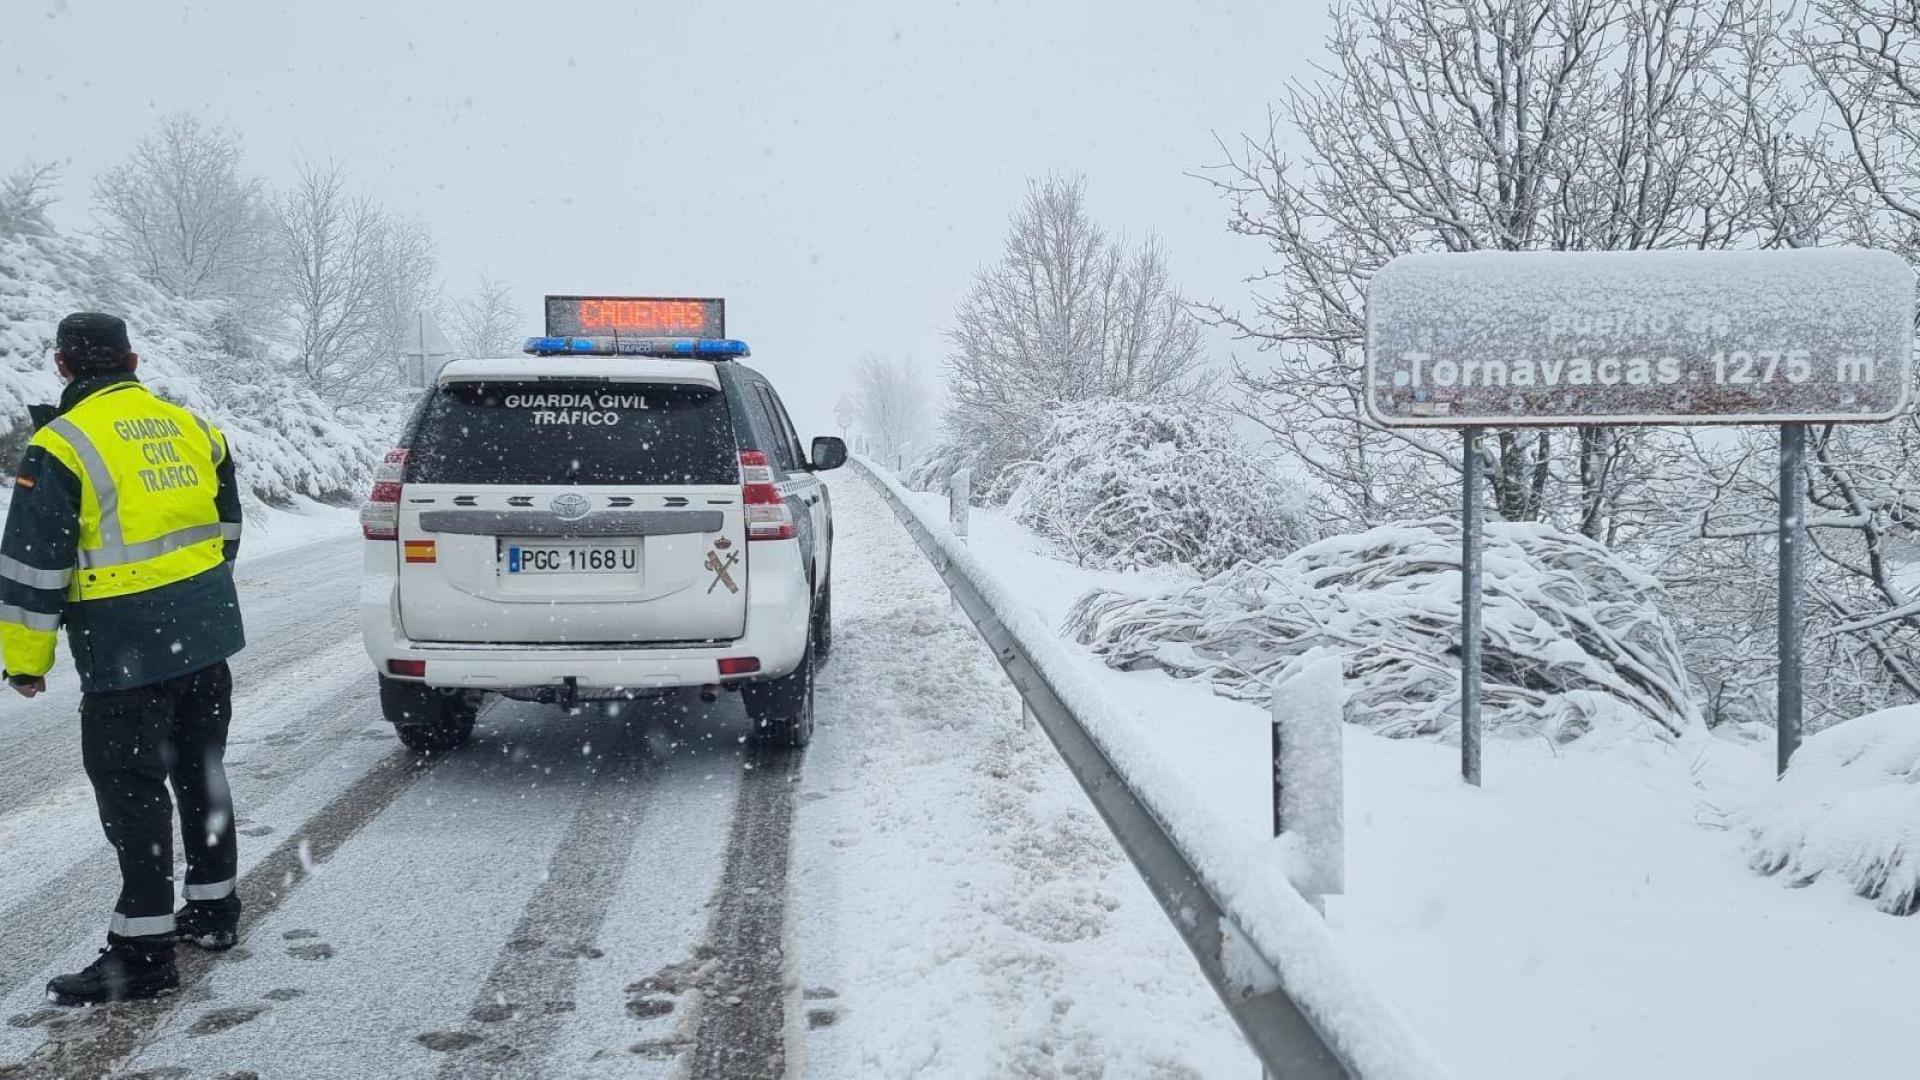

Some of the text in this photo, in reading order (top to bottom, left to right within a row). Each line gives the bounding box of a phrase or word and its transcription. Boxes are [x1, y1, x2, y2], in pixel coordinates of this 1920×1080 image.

[580, 300, 703, 327] CADENAS
[1402, 350, 1873, 386] Tornavacas 1275 m
[505, 394, 649, 409] GUARDIA CIVIL
[114, 418, 184, 441] GUARDIA
[142, 441, 180, 465] CIVIL
[138, 465, 199, 493] TRAFICO
[521, 549, 636, 570] PGC 1168 U
